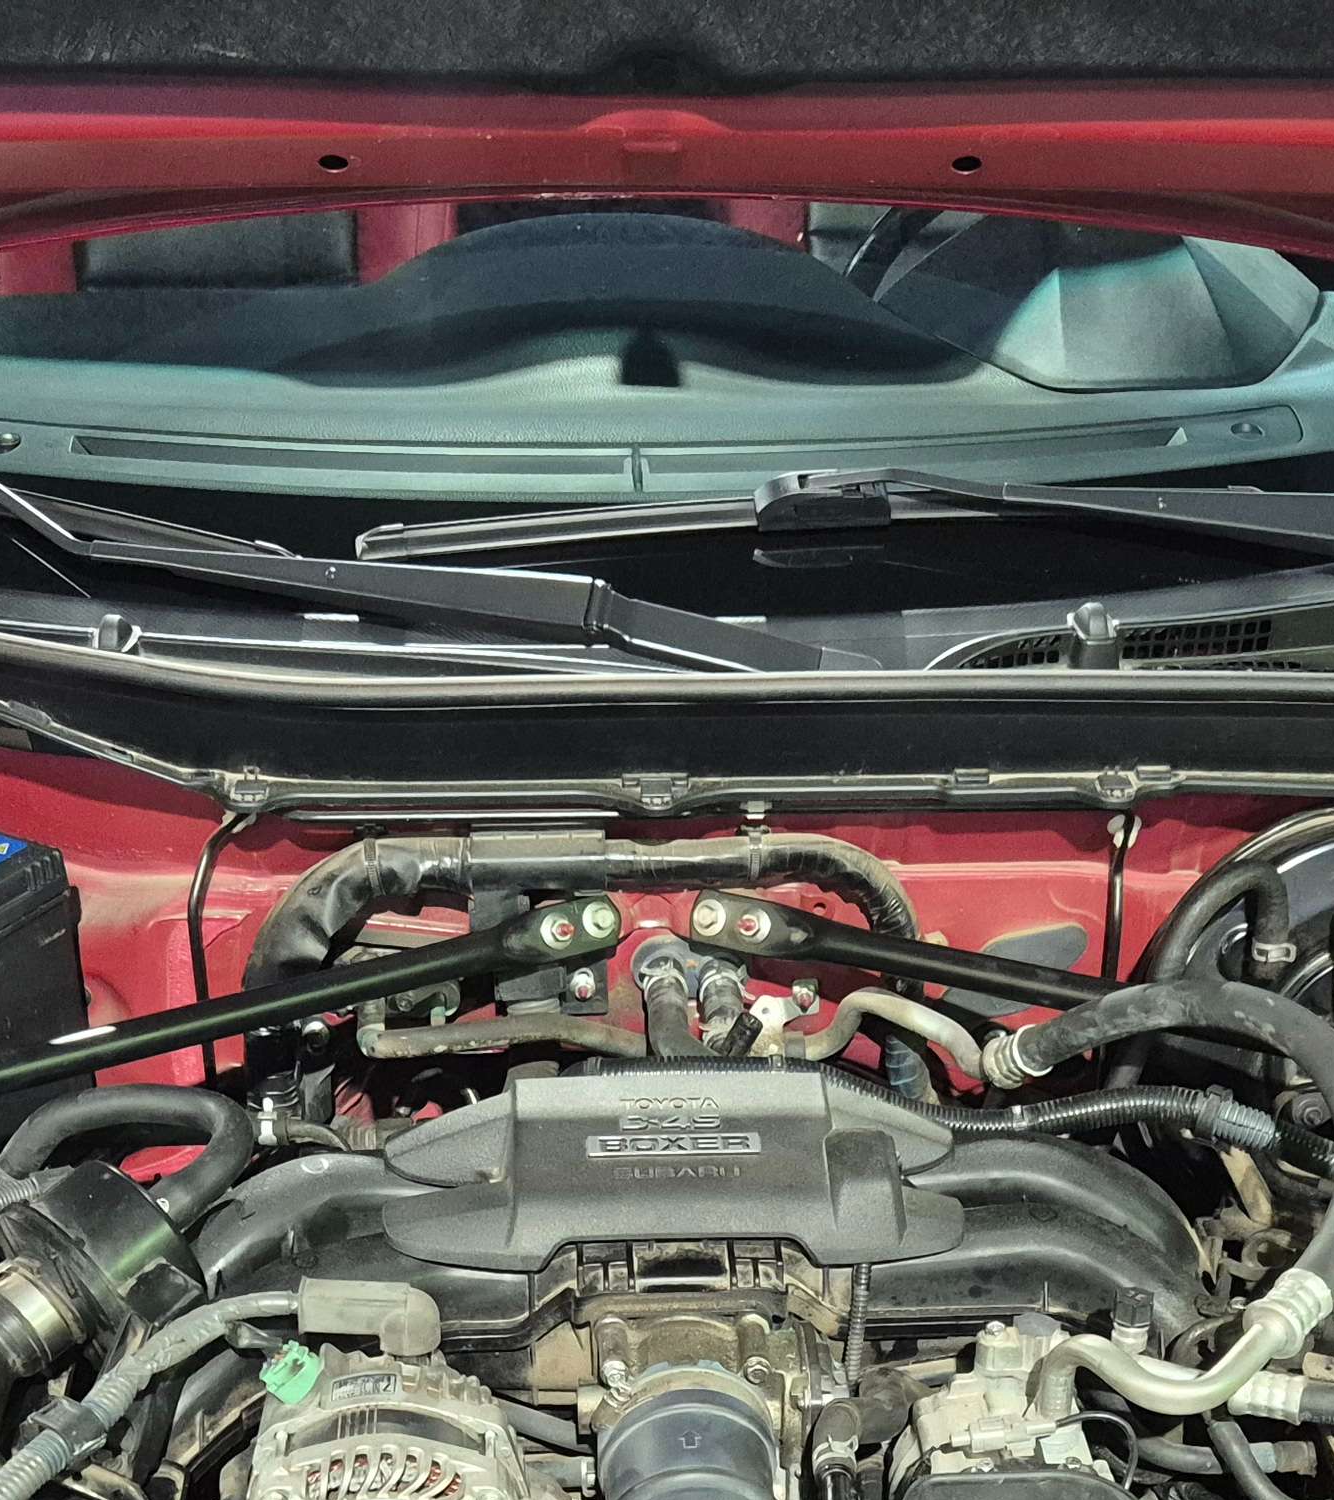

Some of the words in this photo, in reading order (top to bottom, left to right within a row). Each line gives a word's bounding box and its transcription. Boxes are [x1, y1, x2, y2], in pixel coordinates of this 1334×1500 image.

[619, 1096, 720, 1110] TOYOTA
[598, 1135, 751, 1152] BOXER
[612, 1165, 741, 1180] SUBARU
